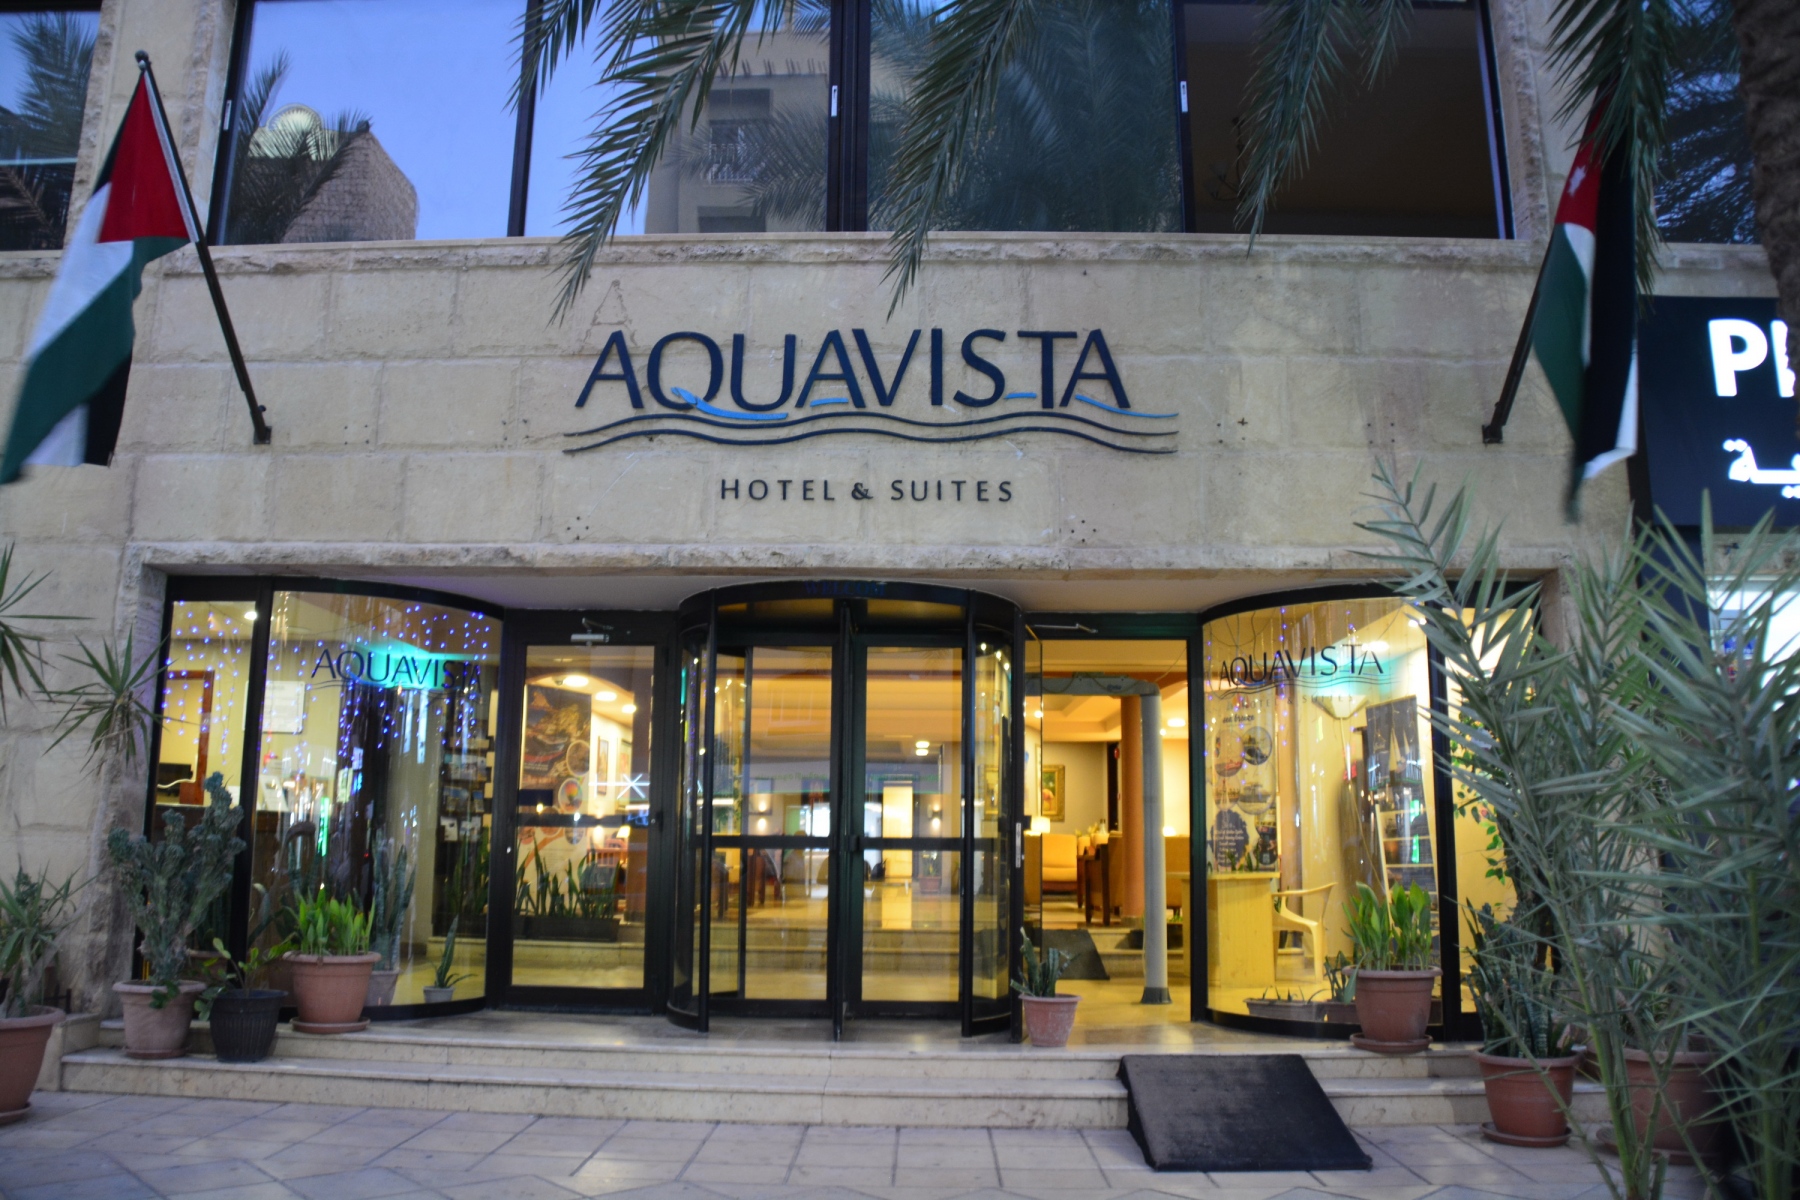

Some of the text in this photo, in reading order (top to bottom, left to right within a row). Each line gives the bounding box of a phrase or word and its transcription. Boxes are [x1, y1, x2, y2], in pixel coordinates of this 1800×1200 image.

[574, 327, 1132, 413] AQUAVISTA
[720, 478, 1013, 502] HOTEL & SUITES
[311, 648, 482, 694] AQUAVISTA
[1219, 644, 1384, 689] AQUAVISTA
